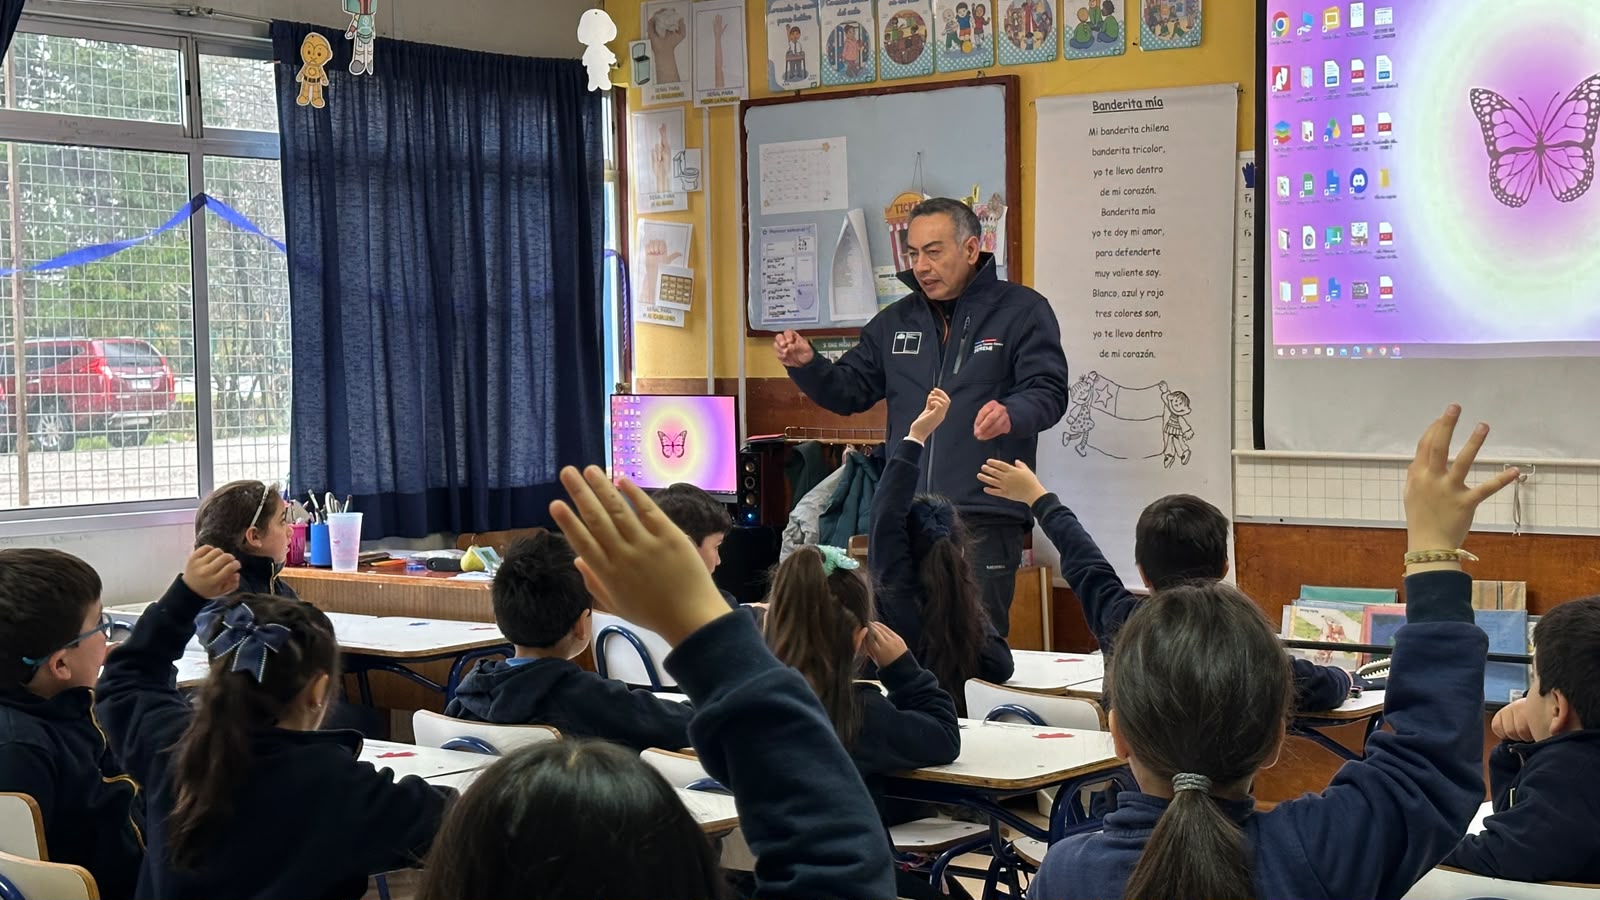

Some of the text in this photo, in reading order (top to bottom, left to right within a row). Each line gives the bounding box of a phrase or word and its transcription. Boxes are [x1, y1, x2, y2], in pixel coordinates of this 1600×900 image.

[1092, 96, 1164, 111] Banderita mía
[1088, 123, 1169, 137] Mi banderita chilena
[1092, 144, 1165, 156] banderita tricolor,
[1093, 166, 1163, 179] yo te llevo dentro
[1100, 185, 1156, 196] de mi corazón.
[1101, 206, 1155, 216] Banderita mía
[1092, 227, 1165, 239] yo te doy mi amor,
[1096, 248, 1161, 259] para defenderte
[1095, 268, 1161, 279] muy valiente soy.
[1093, 289, 1120, 298] Blanco,
[1121, 289, 1137, 297] azul
[1147, 289, 1164, 299] rojo
[1095, 309, 1161, 318] tres colores son,
[1093, 329, 1163, 340] yo te llevo dentro
[1099, 349, 1156, 359] de mi corazón.
